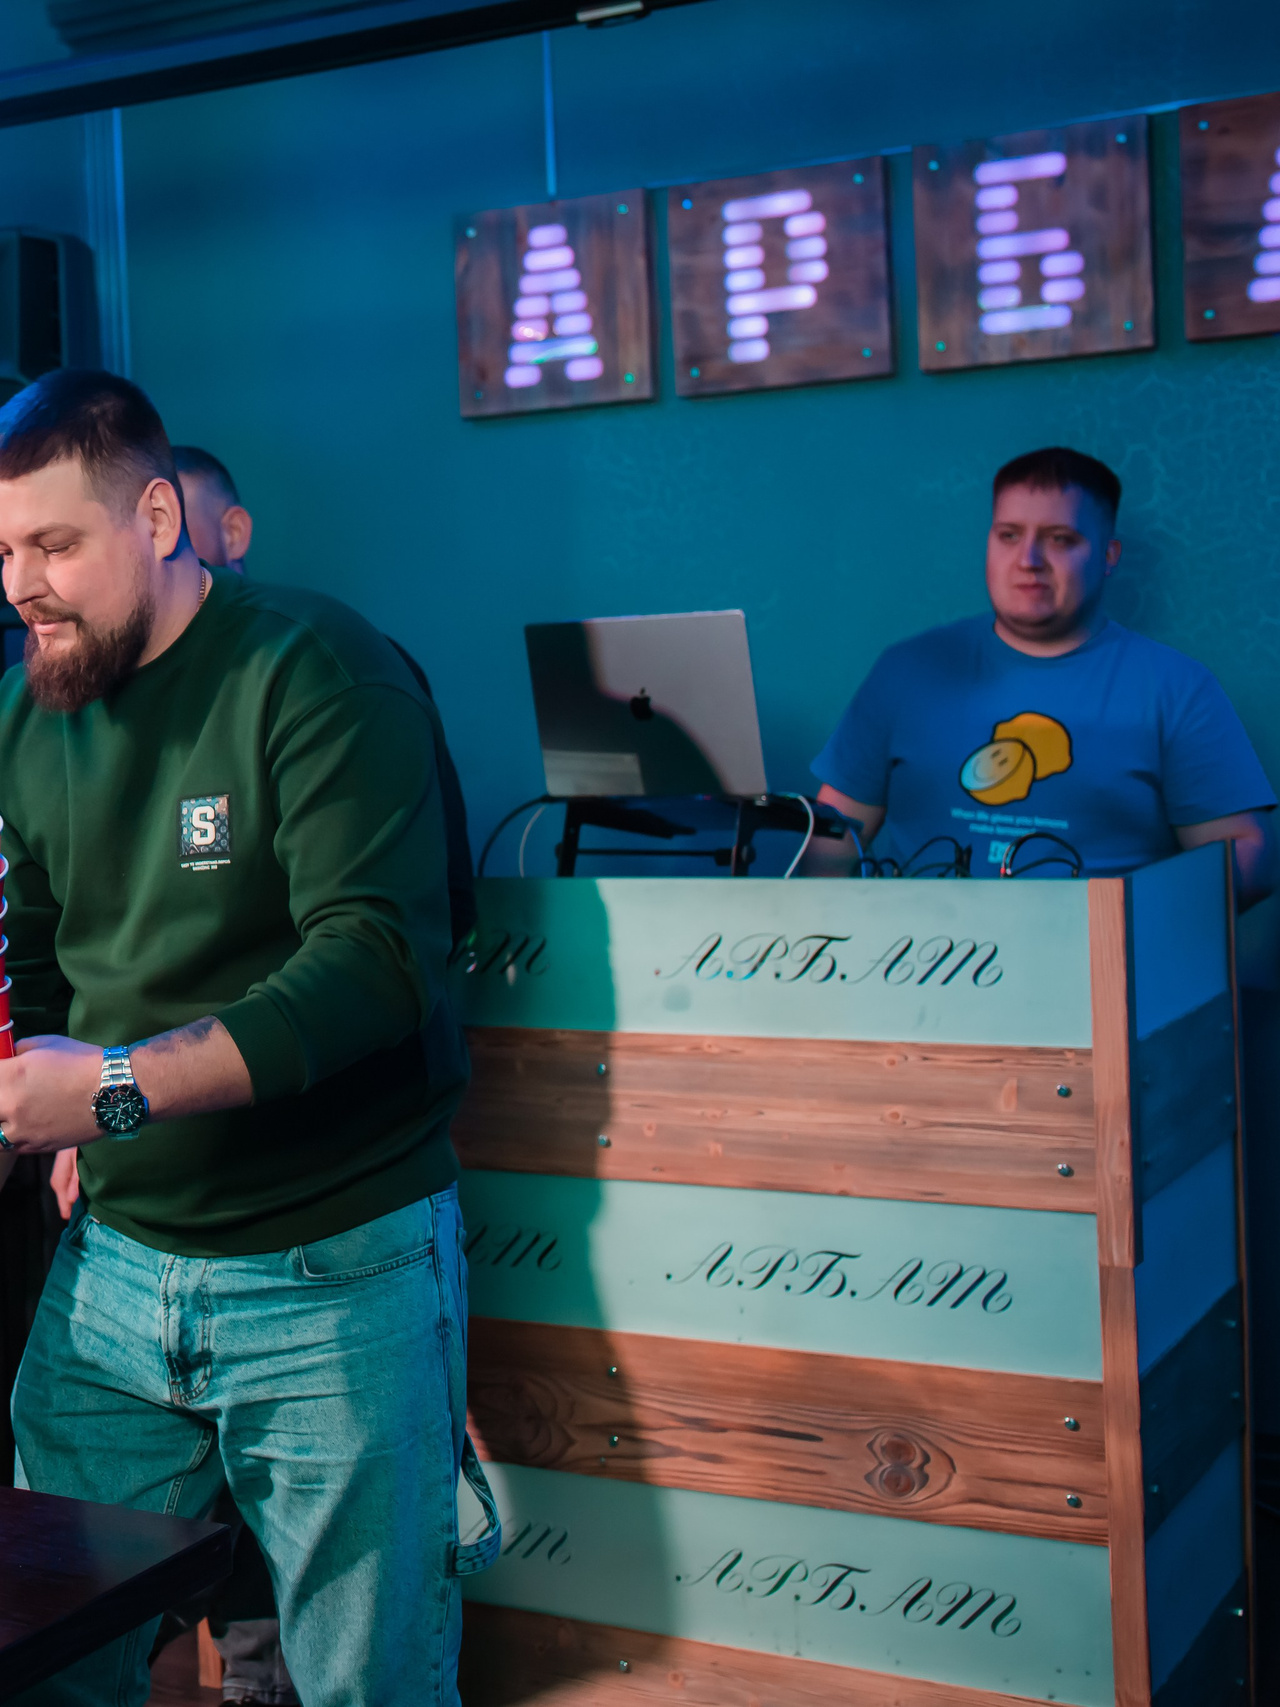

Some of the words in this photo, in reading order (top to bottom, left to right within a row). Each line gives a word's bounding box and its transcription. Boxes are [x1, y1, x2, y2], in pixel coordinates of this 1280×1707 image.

[191, 805, 216, 846] S
[653, 931, 1003, 987] АРБАТ
[665, 1241, 1013, 1314] АРБАТ
[675, 1547, 1022, 1639] АРБАТ
